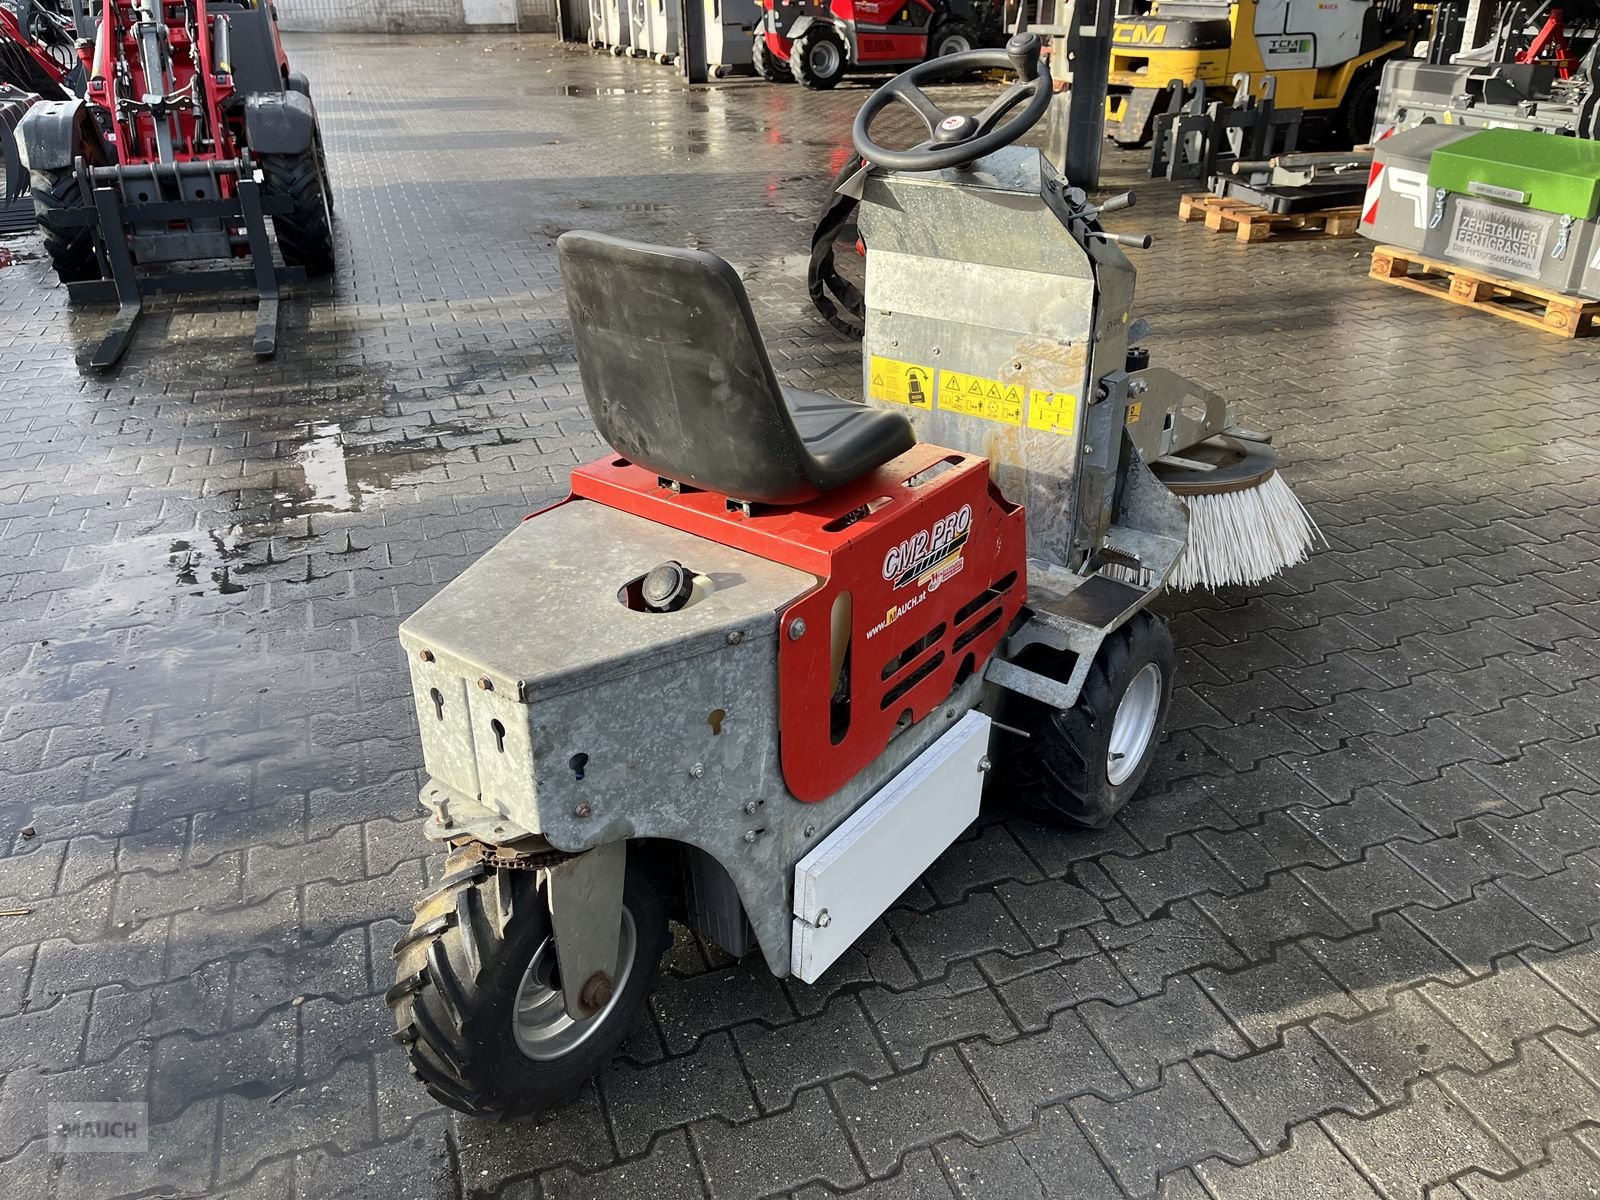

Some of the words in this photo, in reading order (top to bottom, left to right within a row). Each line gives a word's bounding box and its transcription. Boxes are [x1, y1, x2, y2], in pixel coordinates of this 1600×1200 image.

[1113, 22, 1167, 44] CM
[1269, 40, 1299, 48] TCM
[1456, 230, 1537, 260] FERTIGRASEN
[1460, 216, 1538, 245] ZEHETBAUER
[1453, 242, 1465, 252] Das
[882, 529, 930, 580] CM2
[930, 504, 972, 553] PRO
[866, 591, 927, 640] www.MAUCH.at
